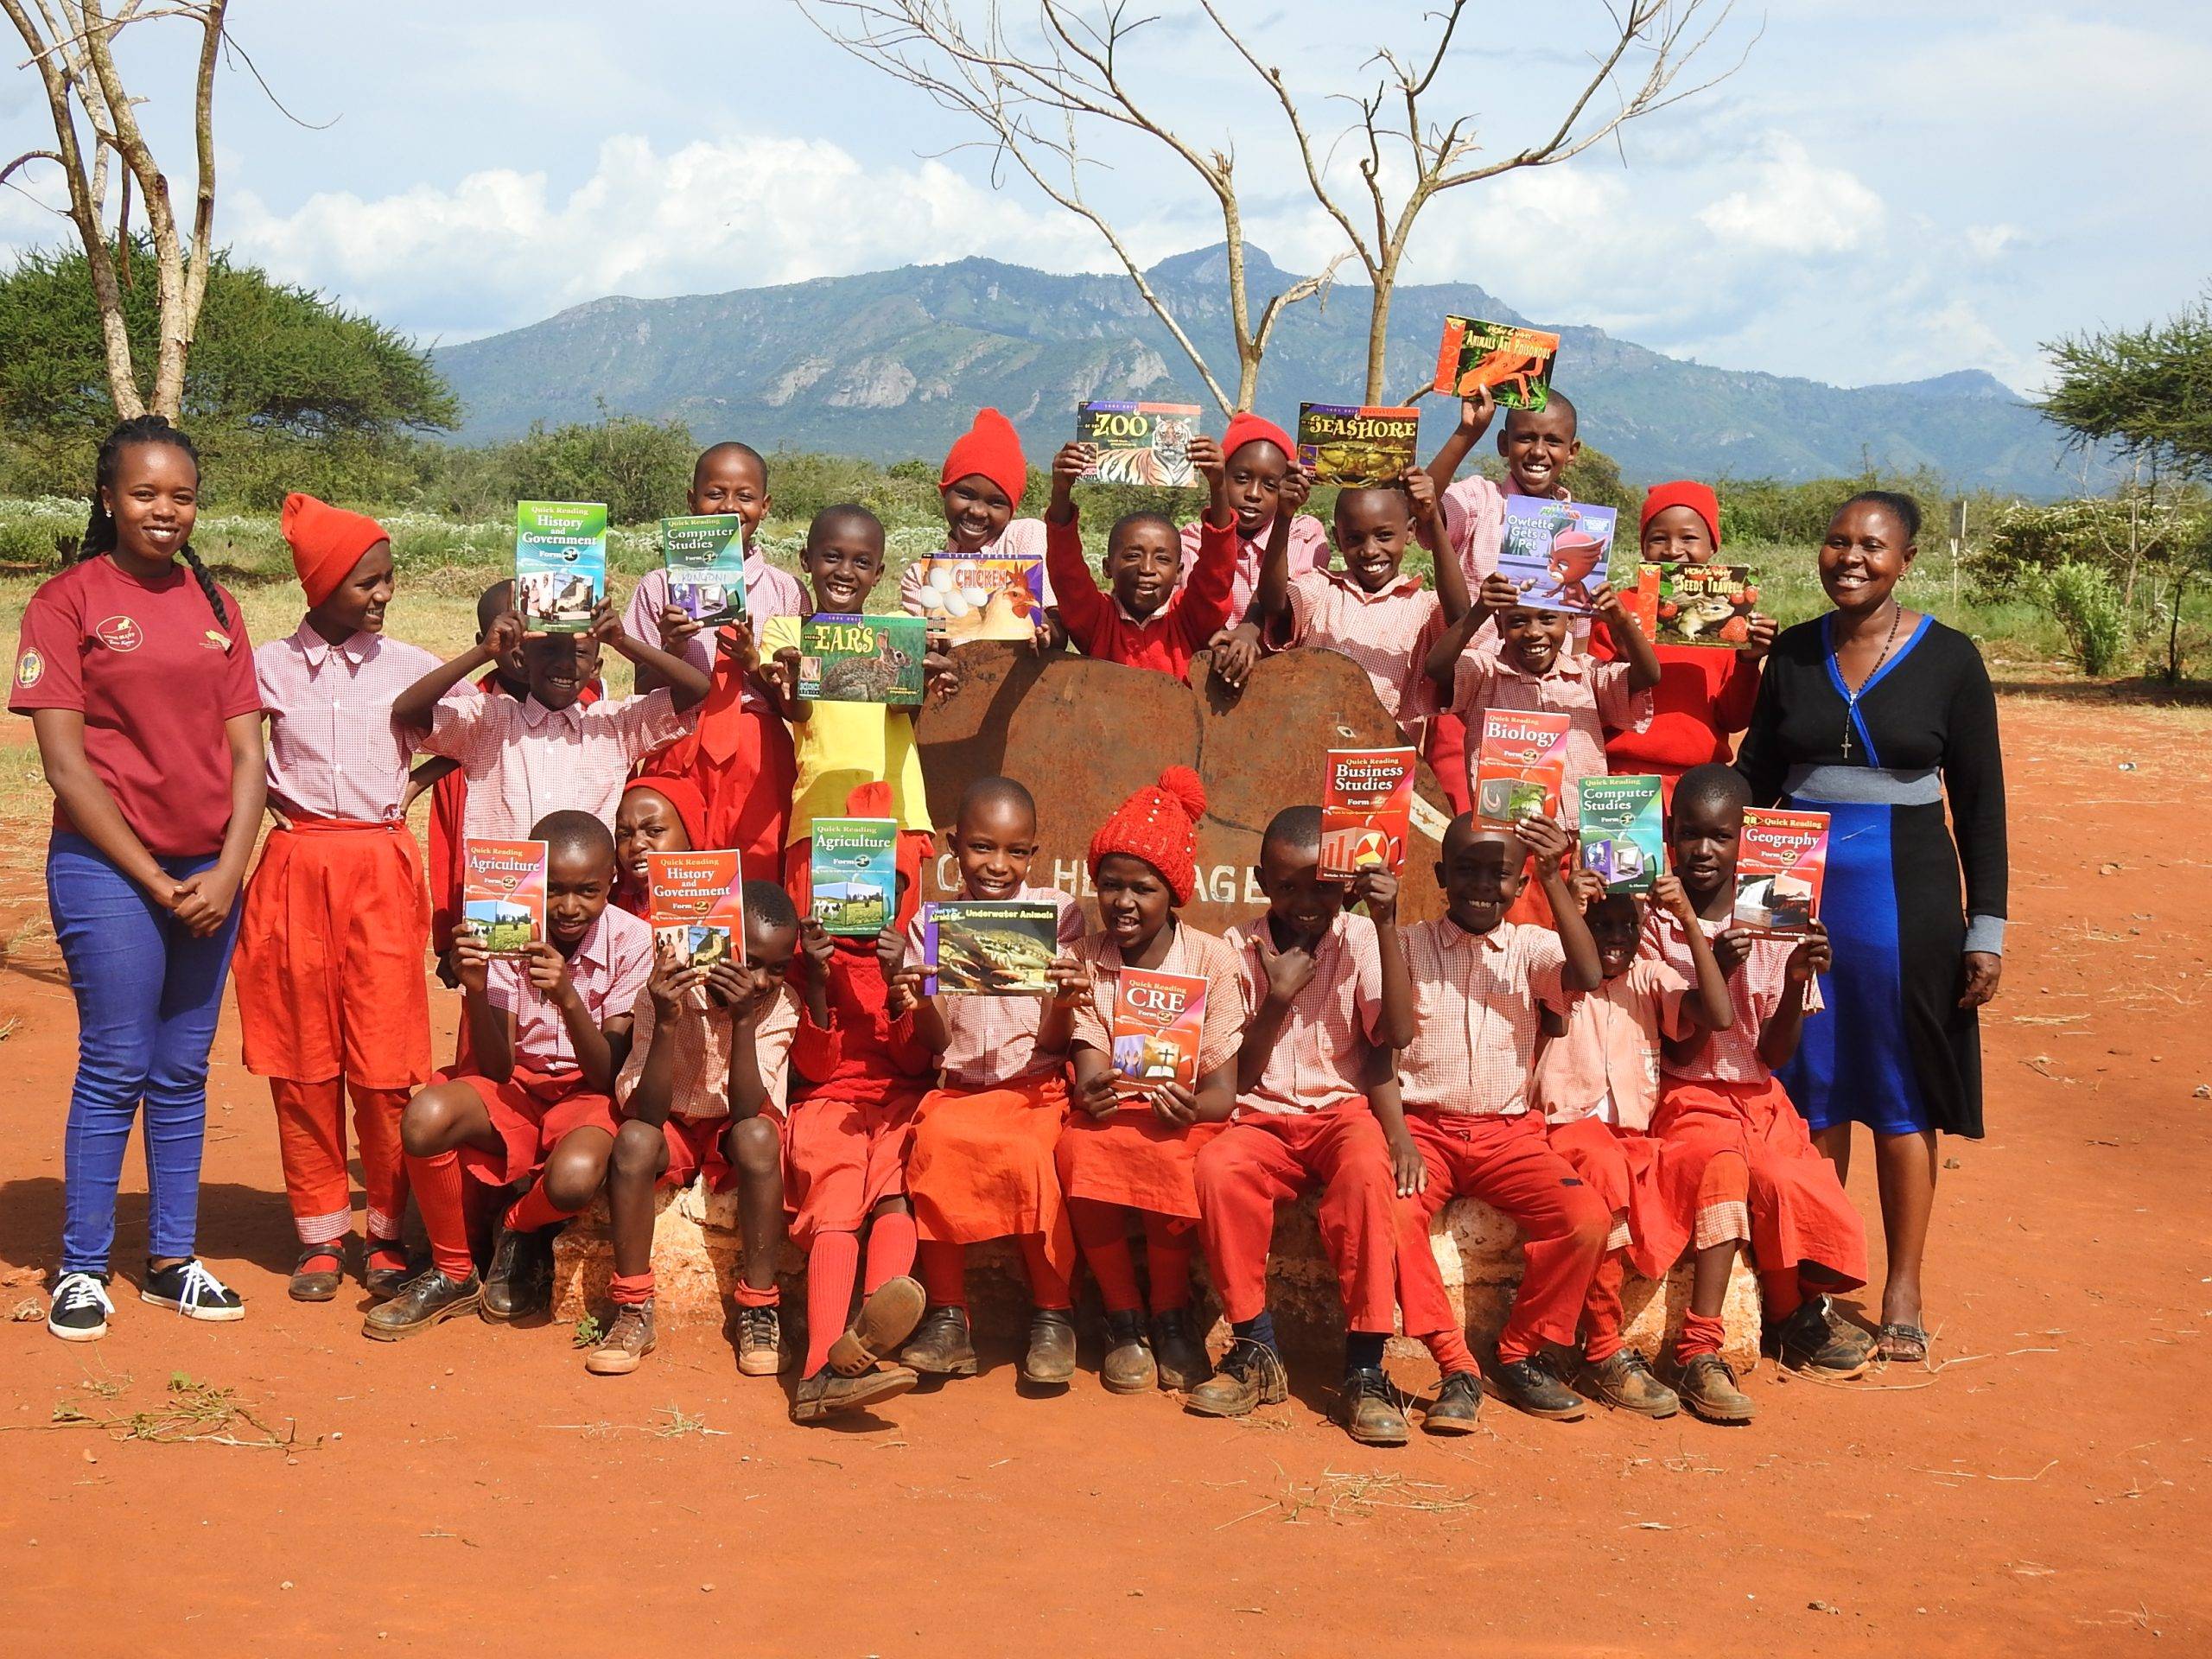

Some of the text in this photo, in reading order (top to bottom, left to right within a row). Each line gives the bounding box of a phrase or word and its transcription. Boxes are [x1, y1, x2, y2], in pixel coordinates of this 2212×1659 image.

[1092, 412, 1147, 437] ZOO
[1310, 415, 1416, 439] SEASHORE
[537, 515, 584, 531] History
[1507, 515, 1555, 531] Owlette
[522, 531, 597, 545] Government
[667, 529, 734, 540] Computer
[1511, 527, 1547, 541] Gets a
[669, 539, 714, 550] Studies
[1518, 537, 1537, 550] Pet
[956, 569, 1007, 588] CHICKEN
[814, 625, 874, 653] EARS
[1510, 717, 1540, 726] Reading
[1487, 721, 1560, 747] Biology
[1336, 764, 1403, 778] Business
[1334, 778, 1393, 791] Studies
[1583, 788, 1656, 801] Computer
[1584, 800, 1631, 810] Studies
[1764, 817, 1789, 826] Quick
[1790, 819, 1821, 829] Reading
[816, 835, 891, 850] Agriculture
[1745, 828, 1821, 849] Geography
[493, 849, 524, 857] Reading
[469, 855, 540, 873] Agriculture
[667, 868, 715, 881] History
[653, 885, 731, 897] Government
[965, 909, 1018, 918] Underwater
[1020, 910, 1054, 919] Animals
[1128, 980, 1187, 994] Quick Reading
[1126, 987, 1185, 1013] CRE
[1138, 1009, 1157, 1018] Form
